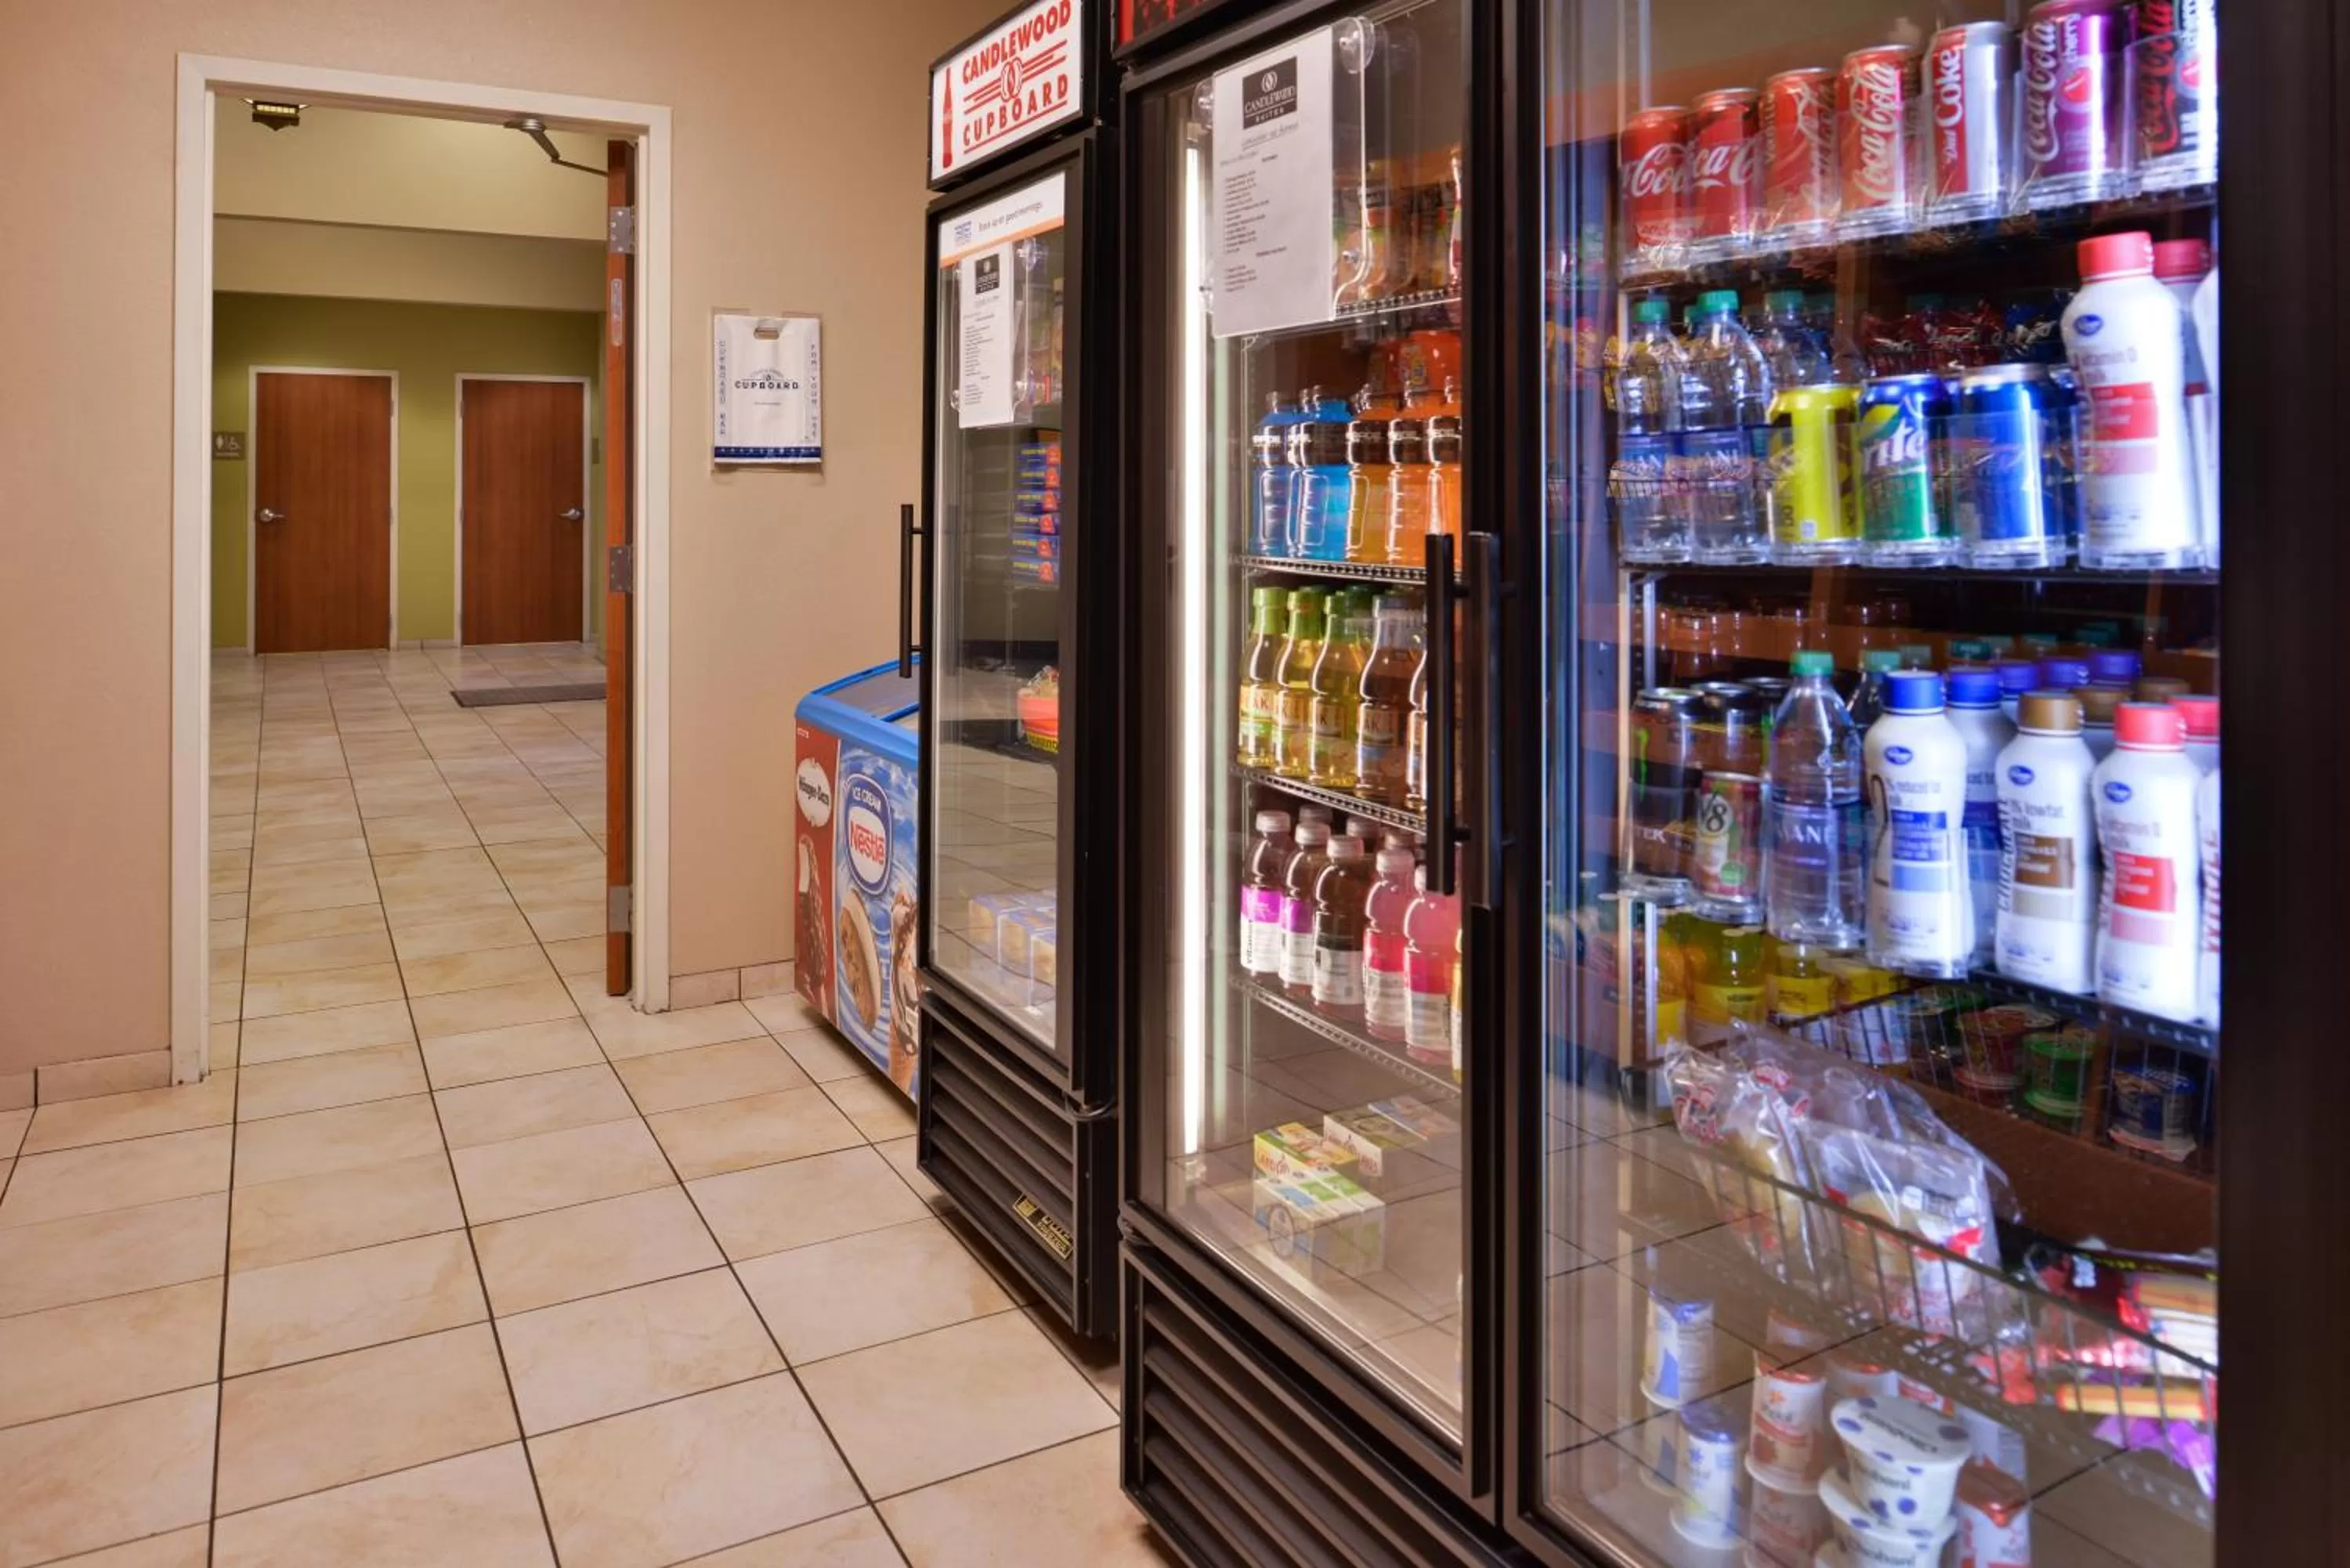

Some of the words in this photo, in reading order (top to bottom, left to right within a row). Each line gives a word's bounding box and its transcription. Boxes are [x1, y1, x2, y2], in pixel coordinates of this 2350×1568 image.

[962, 0, 1071, 85] CANDLEWOOD
[963, 73, 1068, 146] CUPBOARD
[1934, 49, 1963, 128] Coke
[1697, 791, 1728, 833] V8
